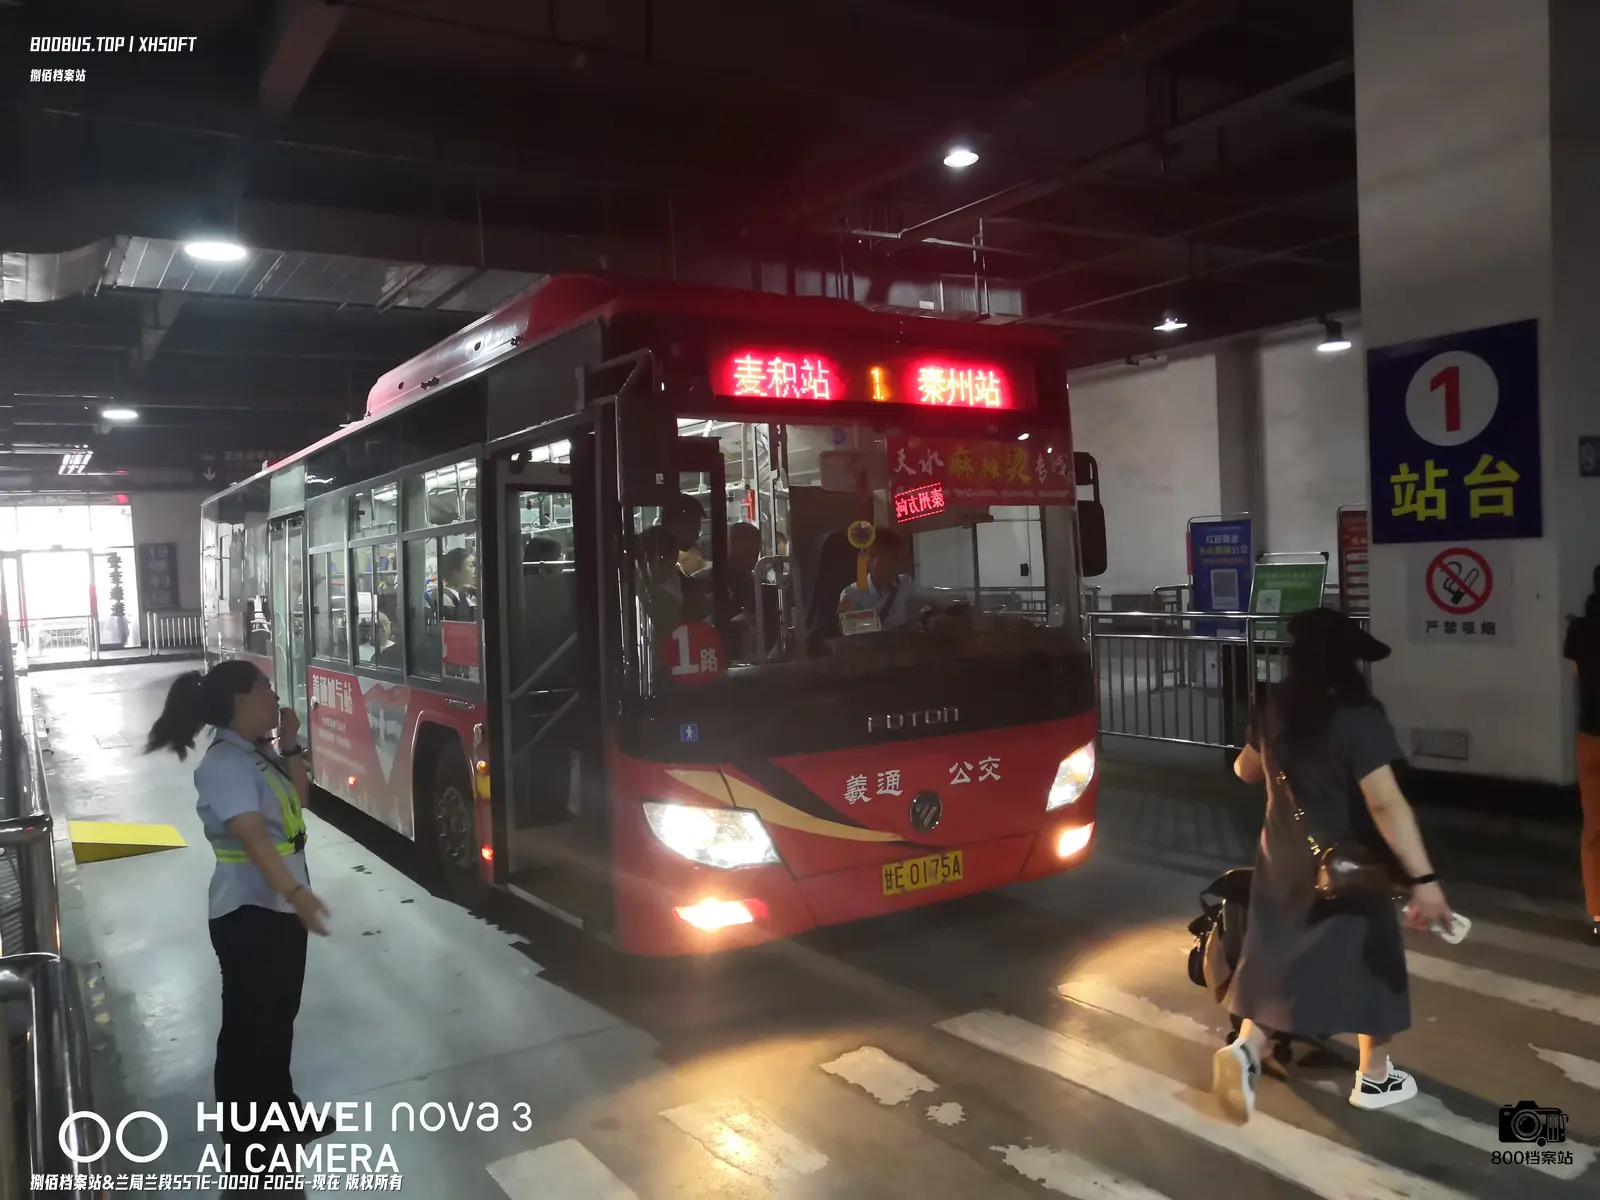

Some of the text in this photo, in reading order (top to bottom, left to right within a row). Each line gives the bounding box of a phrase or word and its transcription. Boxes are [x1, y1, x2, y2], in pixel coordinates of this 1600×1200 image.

[732, 354, 831, 400] 麦积站
[869, 366, 886, 402] 1
[916, 366, 1001, 408] 秦州站
[1430, 365, 1461, 432] 1
[1389, 454, 1521, 521] 站台
[1425, 620, 1497, 637] 严禁吸烟
